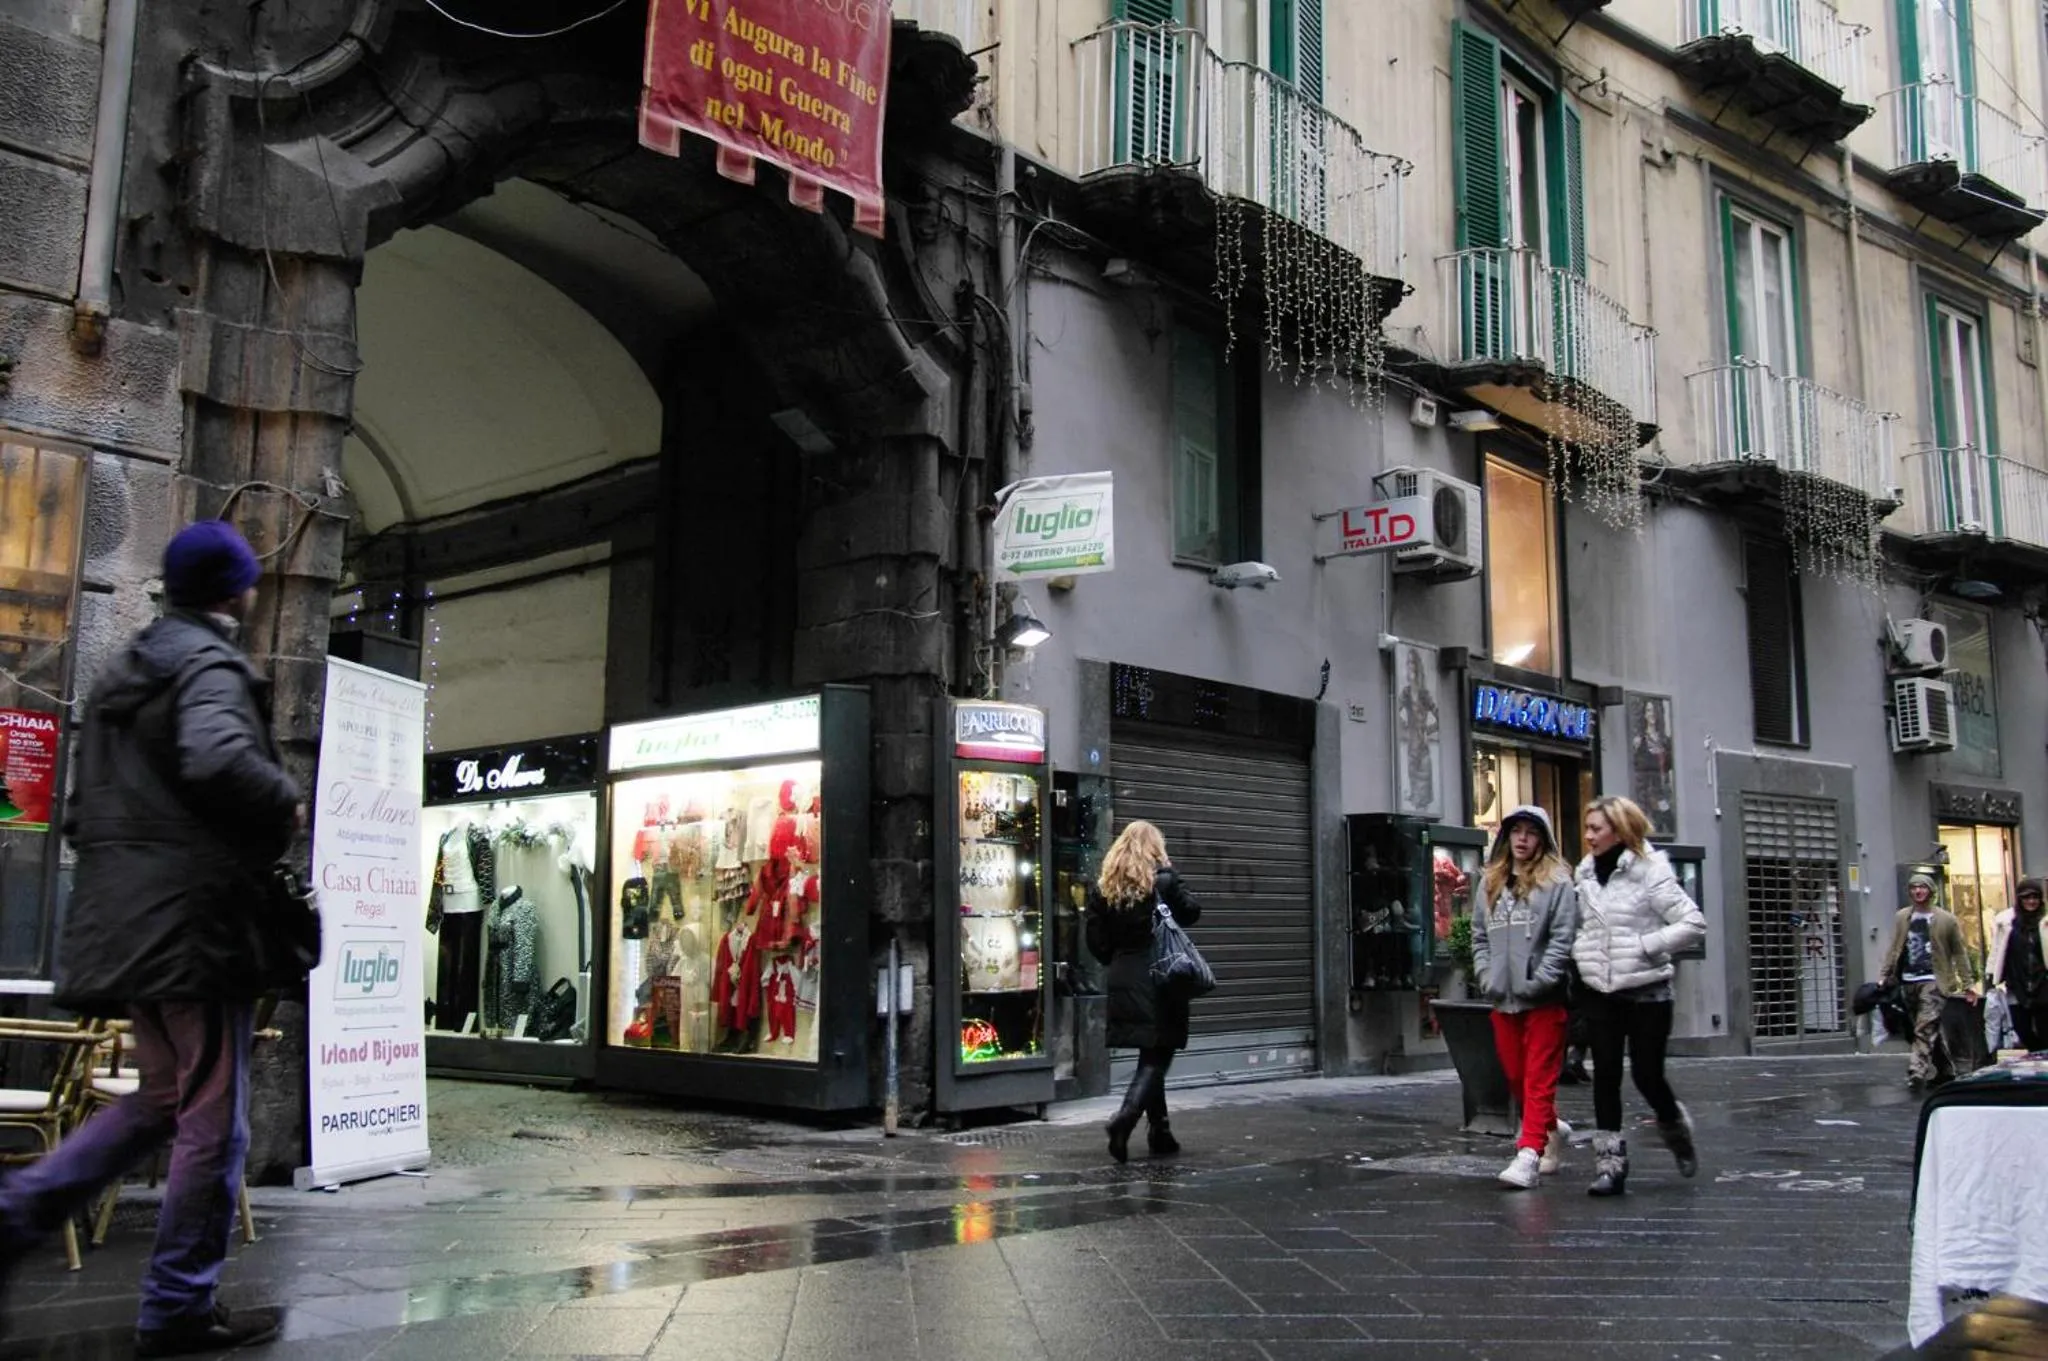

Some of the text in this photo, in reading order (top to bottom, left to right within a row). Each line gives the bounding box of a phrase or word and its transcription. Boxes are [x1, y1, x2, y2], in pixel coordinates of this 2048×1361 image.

[722, 6, 805, 66] Augura
[812, 46, 831, 80] la
[836, 60, 877, 105] Fine
[689, 39, 850, 134] di ogni Guerra
[705, 96, 745, 130] nel
[1015, 502, 1093, 540] luglio
[1342, 507, 1416, 543] LTD
[1343, 535, 1389, 550] ITALIA
[326, 781, 358, 818] De
[322, 862, 417, 896] Casa Chiaia
[343, 949, 399, 993] luglio
[321, 1040, 420, 1066] Island Bijoux
[321, 1103, 421, 1134] PARRUCCHIERI
